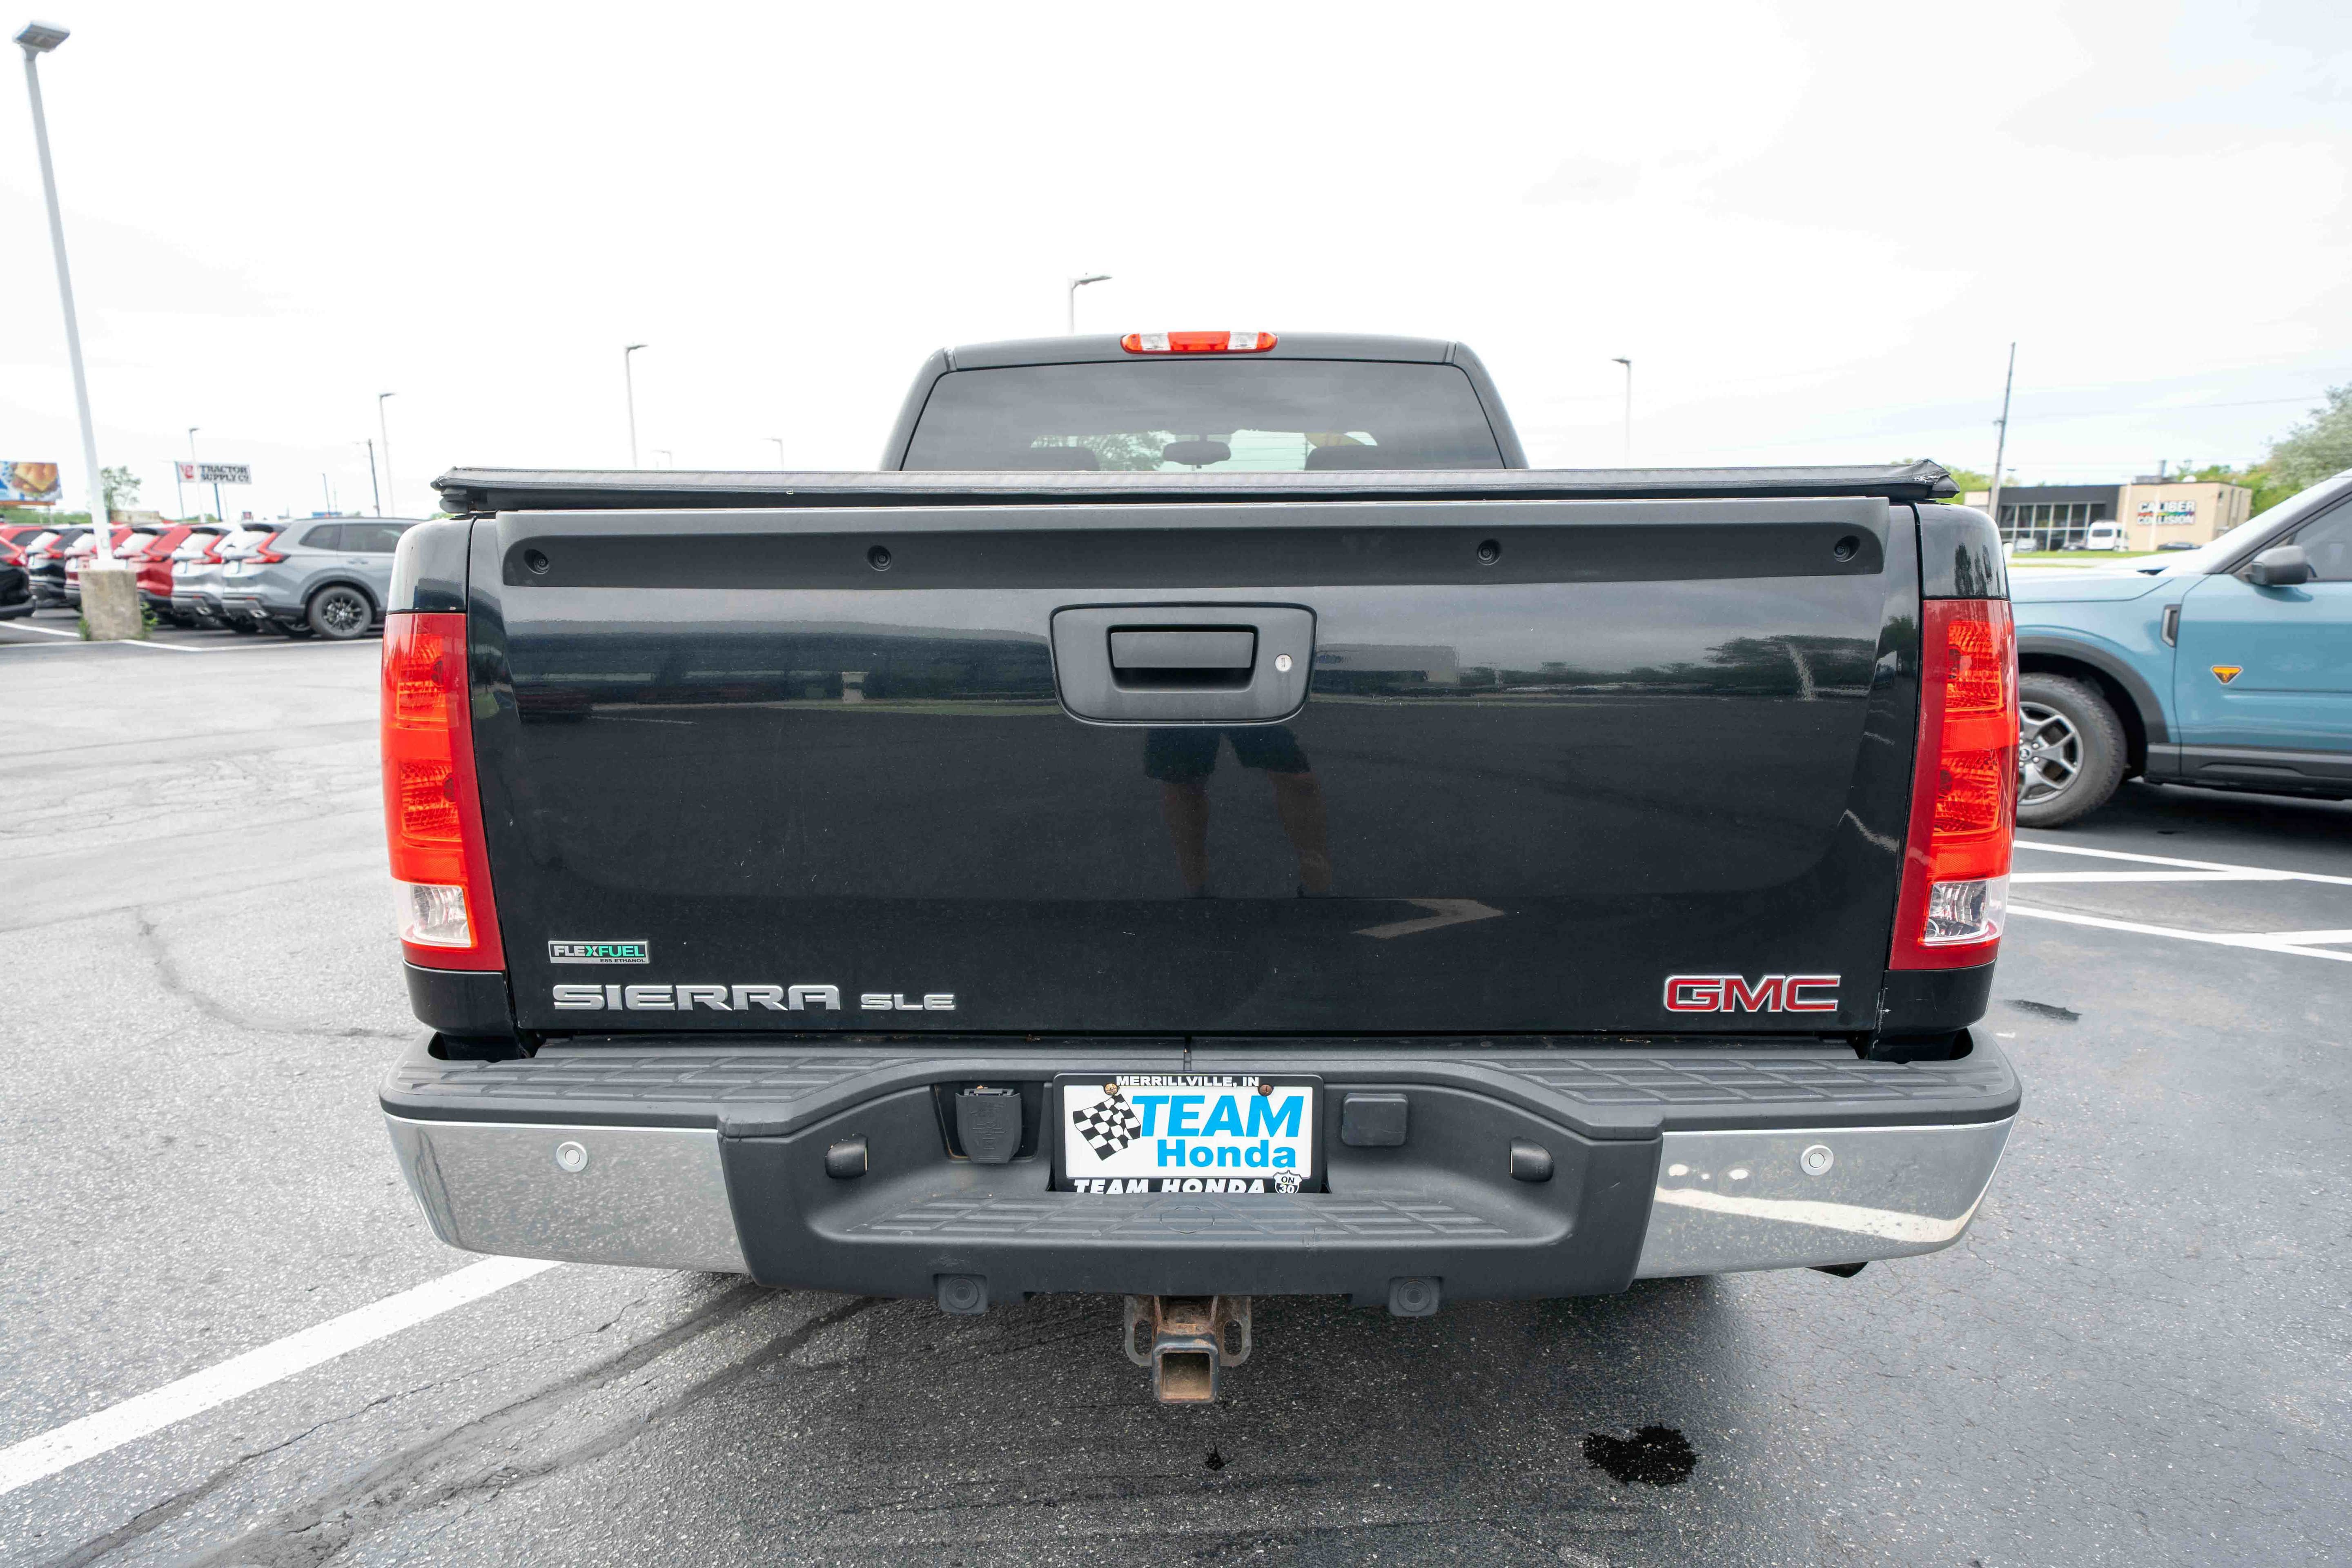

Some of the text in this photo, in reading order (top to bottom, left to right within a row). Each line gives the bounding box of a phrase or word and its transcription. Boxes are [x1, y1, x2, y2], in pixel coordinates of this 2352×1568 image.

[199, 465, 248, 473] TRACTOR
[2138, 501, 2195, 512] CALIBER
[2137, 516, 2195, 525] COLLISION
[554, 945, 645, 957] FLEXFUEL
[553, 984, 956, 1011] SIERRA SLE
[1664, 974, 1841, 1013] GMC
[1116, 1076, 1259, 1087] MERRILLVILLE, IN
[1132, 1095, 1304, 1137] TEAM
[1157, 1139, 1296, 1168] Honda
[1074, 1178, 1265, 1194] TEAM HONDA
[1278, 1184, 1295, 1194] 30
